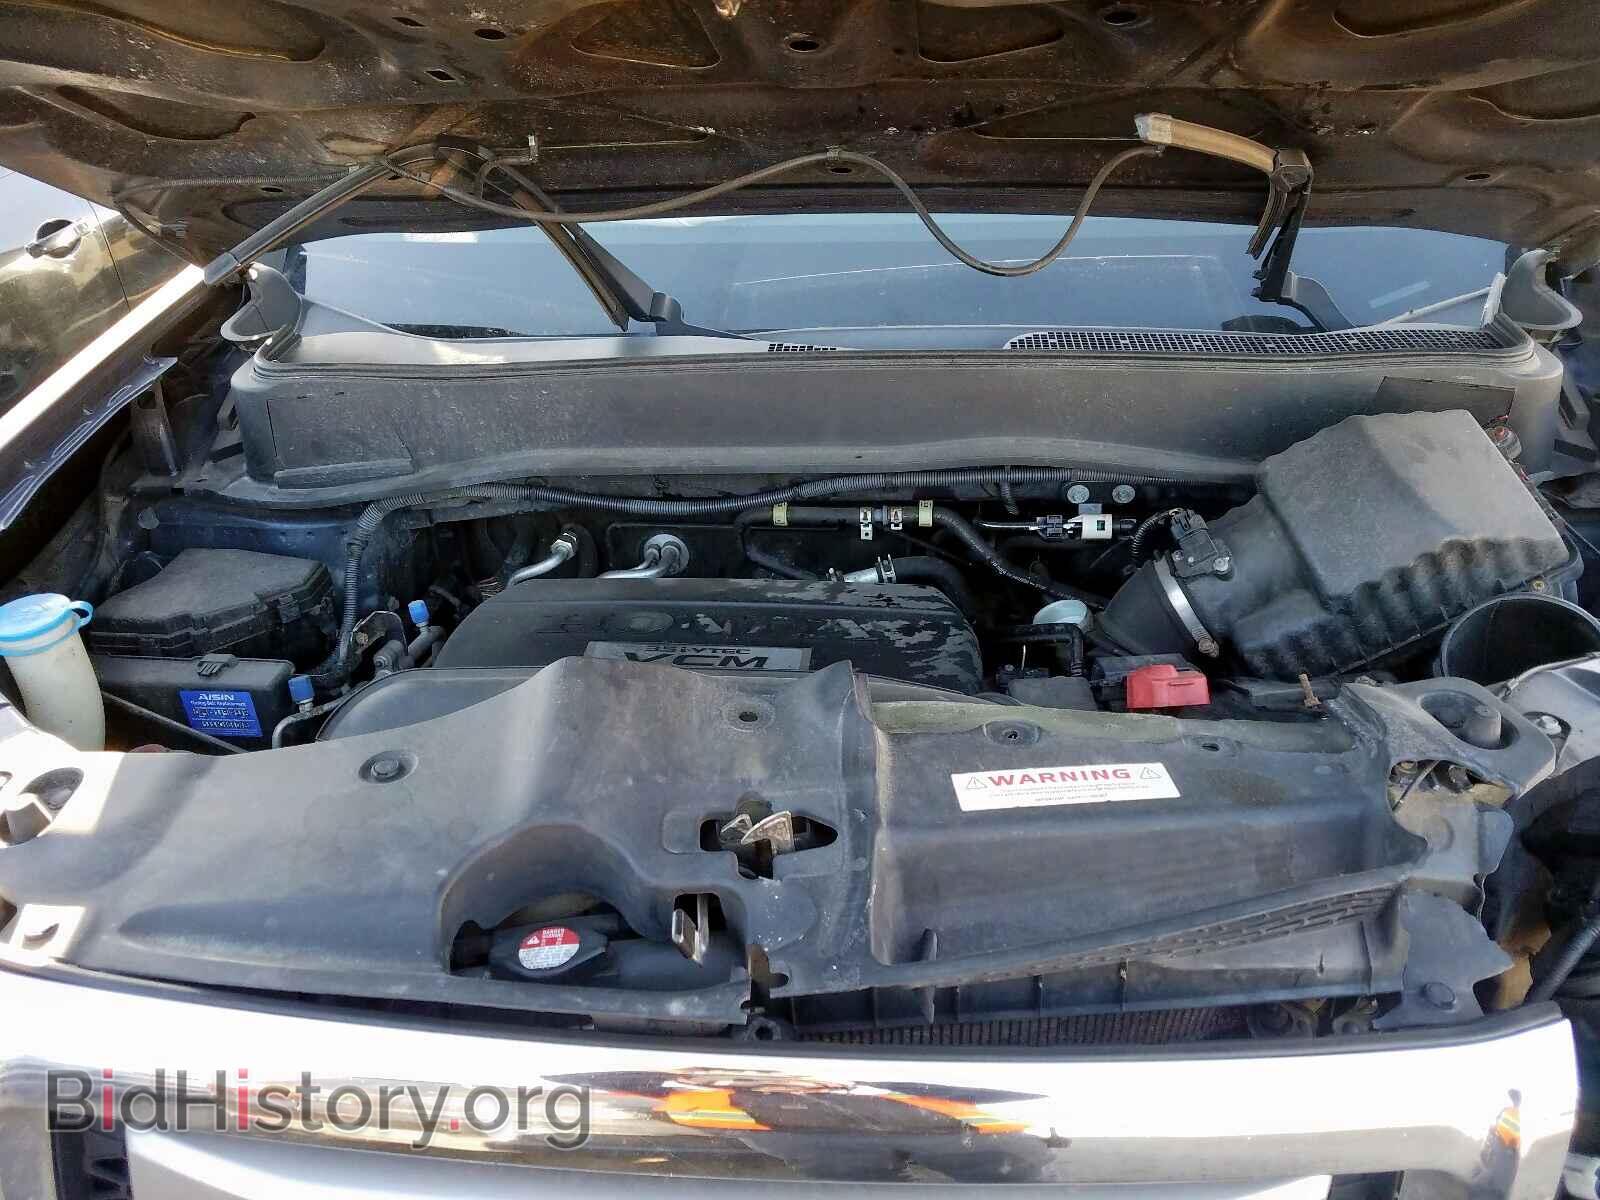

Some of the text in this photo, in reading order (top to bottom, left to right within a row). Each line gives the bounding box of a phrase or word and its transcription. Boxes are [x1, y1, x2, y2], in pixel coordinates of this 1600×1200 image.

[624, 652, 769, 668] VCM
[198, 693, 235, 701] AISIN
[987, 767, 1132, 787] WARNING
